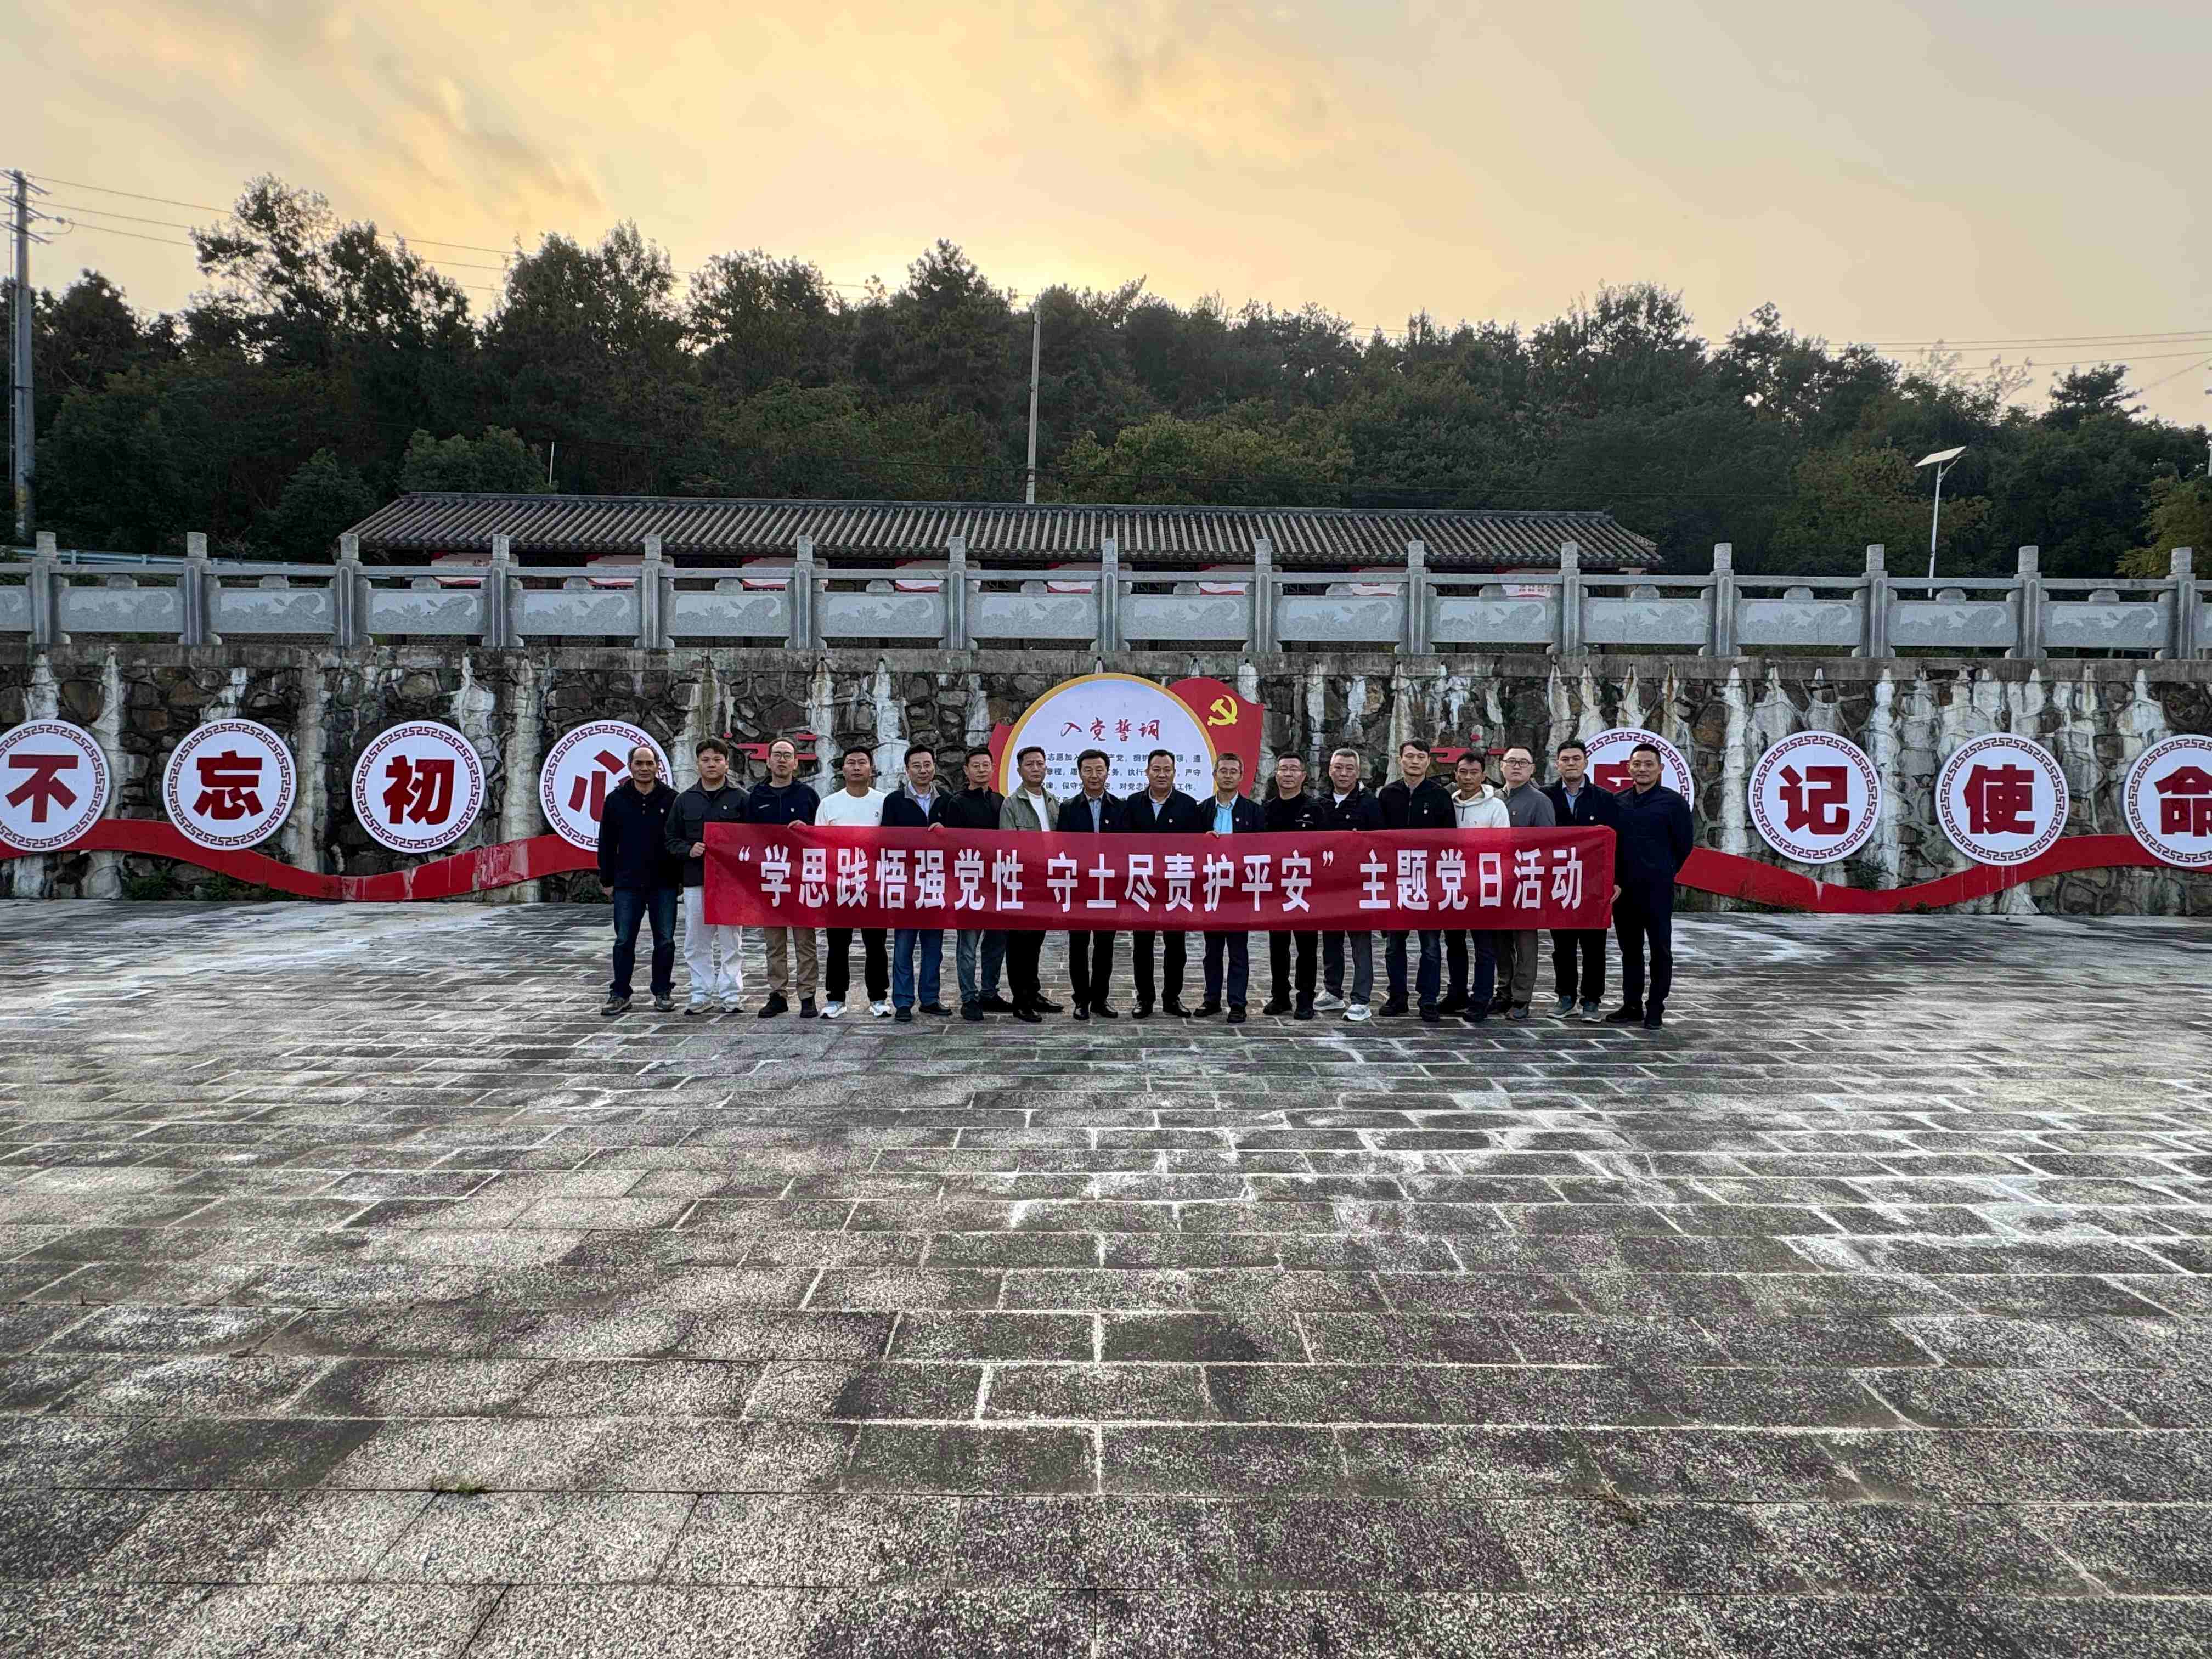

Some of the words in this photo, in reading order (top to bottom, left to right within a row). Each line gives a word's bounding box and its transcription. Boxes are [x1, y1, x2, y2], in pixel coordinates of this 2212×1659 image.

[1060, 716, 1160, 742] 入党誓词
[6, 754, 78, 822] 不
[193, 751, 263, 820] 忘
[383, 755, 455, 825] 初
[1779, 765, 1849, 834] 记
[1963, 764, 2035, 834] 使
[2154, 766, 2212, 837] 命
[738, 844, 1024, 911] “学思践悟强党性
[1047, 849, 1334, 912] 守土尽责护平安”
[1359, 847, 1582, 910] 主题党日活动
